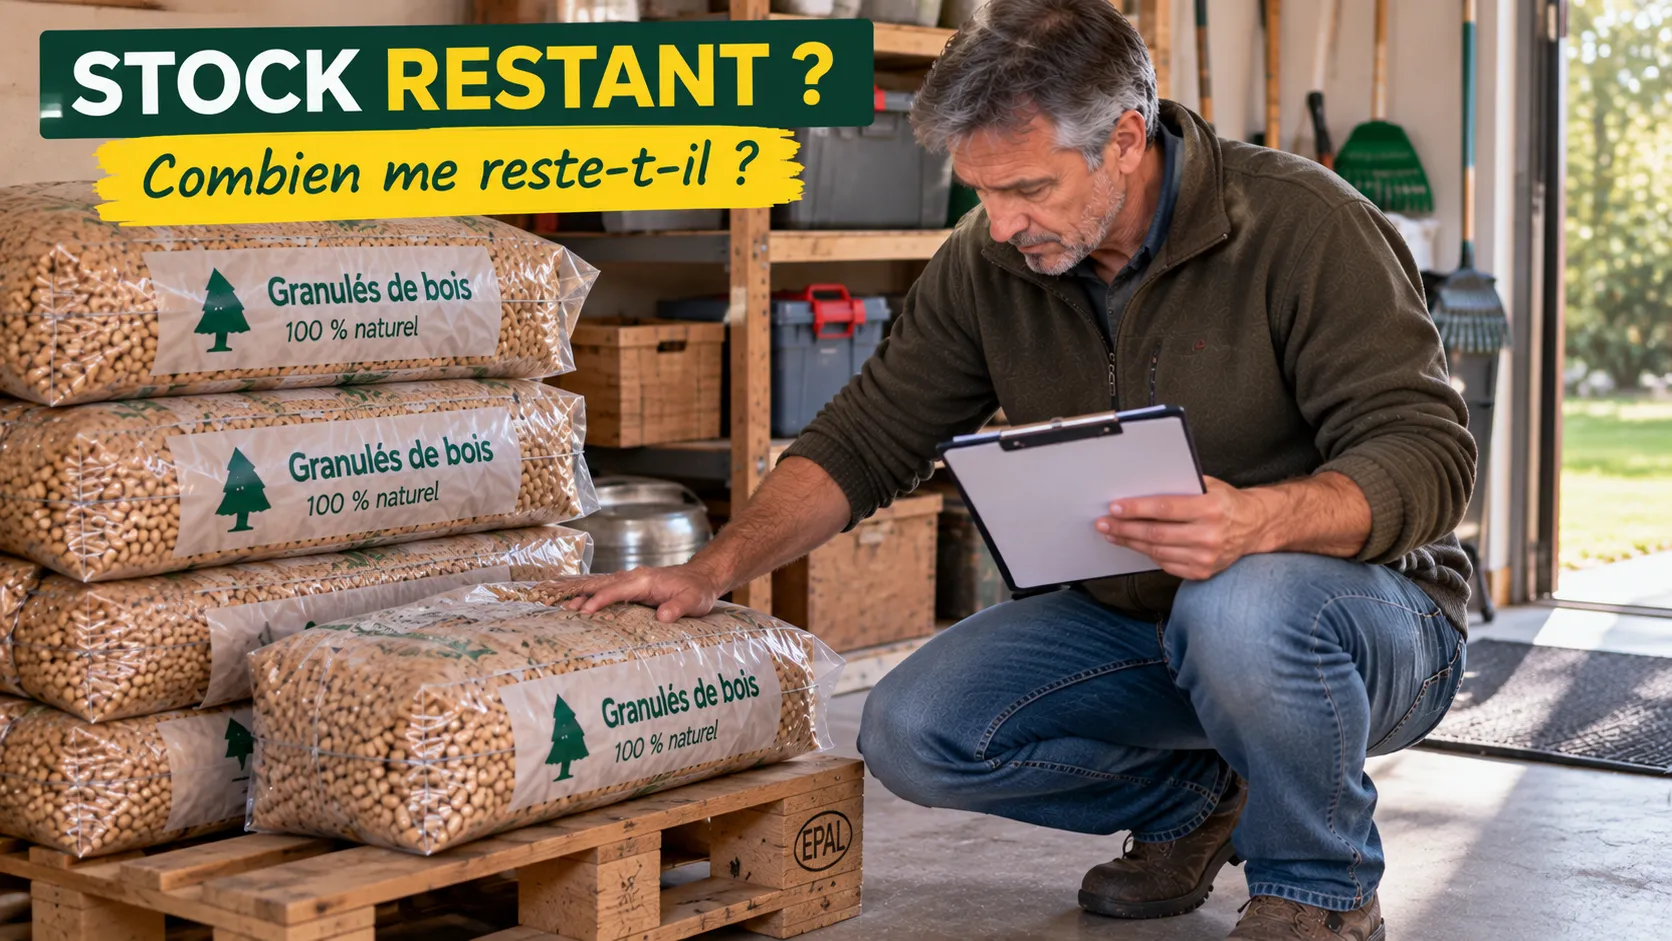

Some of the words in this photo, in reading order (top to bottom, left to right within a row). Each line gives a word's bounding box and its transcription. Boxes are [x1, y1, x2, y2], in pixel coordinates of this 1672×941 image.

[268, 273, 381, 306] Granulés
[388, 273, 418, 303] de
[422, 271, 473, 301] bois
[286, 320, 323, 342] 100
[331, 320, 348, 340] %
[355, 316, 419, 338] naturel
[289, 443, 403, 482] Granulés
[409, 440, 440, 470] de
[443, 434, 494, 466] bois
[308, 493, 344, 516] 100
[352, 491, 369, 512] %
[376, 480, 439, 509] naturel
[602, 683, 690, 729] Granulés
[694, 677, 718, 709] de
[719, 669, 760, 703] bois
[616, 737, 645, 763] 100
[650, 734, 664, 754] %
[668, 719, 719, 750] naturel
[802, 821, 846, 862] EPAL
